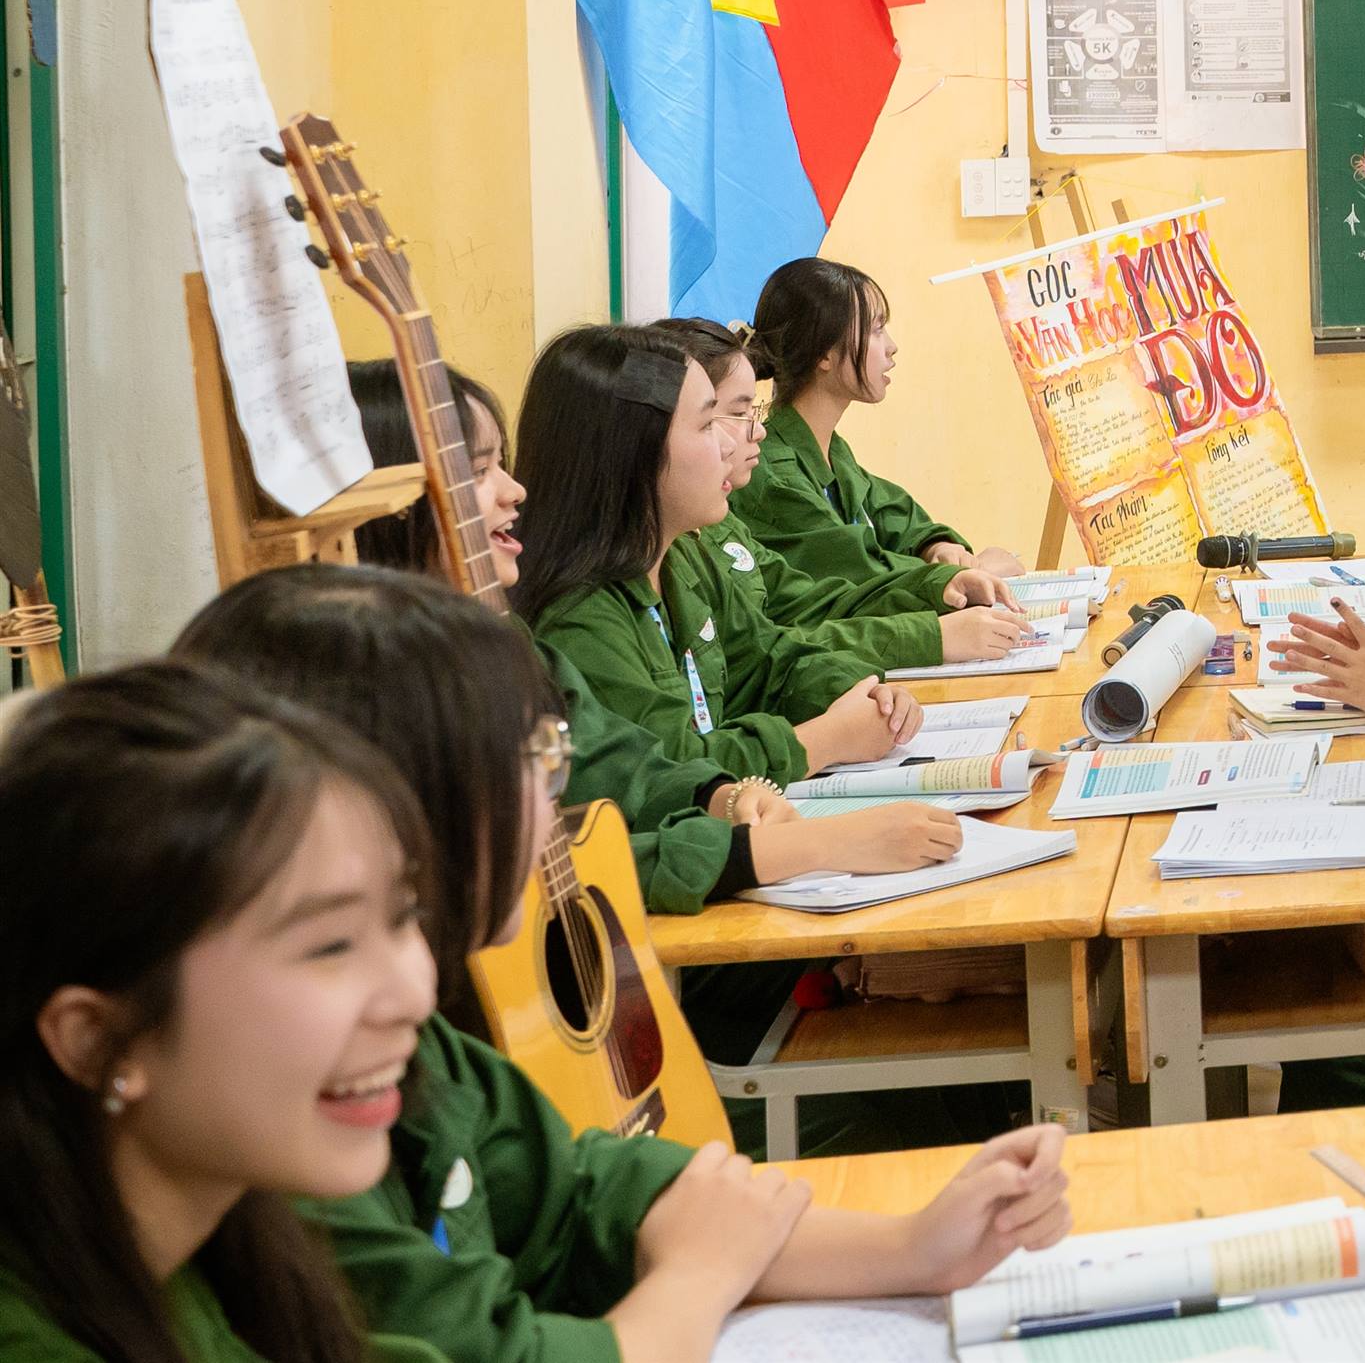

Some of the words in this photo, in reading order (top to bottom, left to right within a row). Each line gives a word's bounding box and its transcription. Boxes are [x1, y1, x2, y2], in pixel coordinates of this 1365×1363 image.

[1093, 42, 1112, 54] 5K
[1028, 253, 1076, 308] GÓC
[1115, 218, 1236, 337] MƯA
[1017, 314, 1078, 370] VĂN
[1037, 384, 1062, 409] Tác
[1090, 505, 1116, 535] Tác
